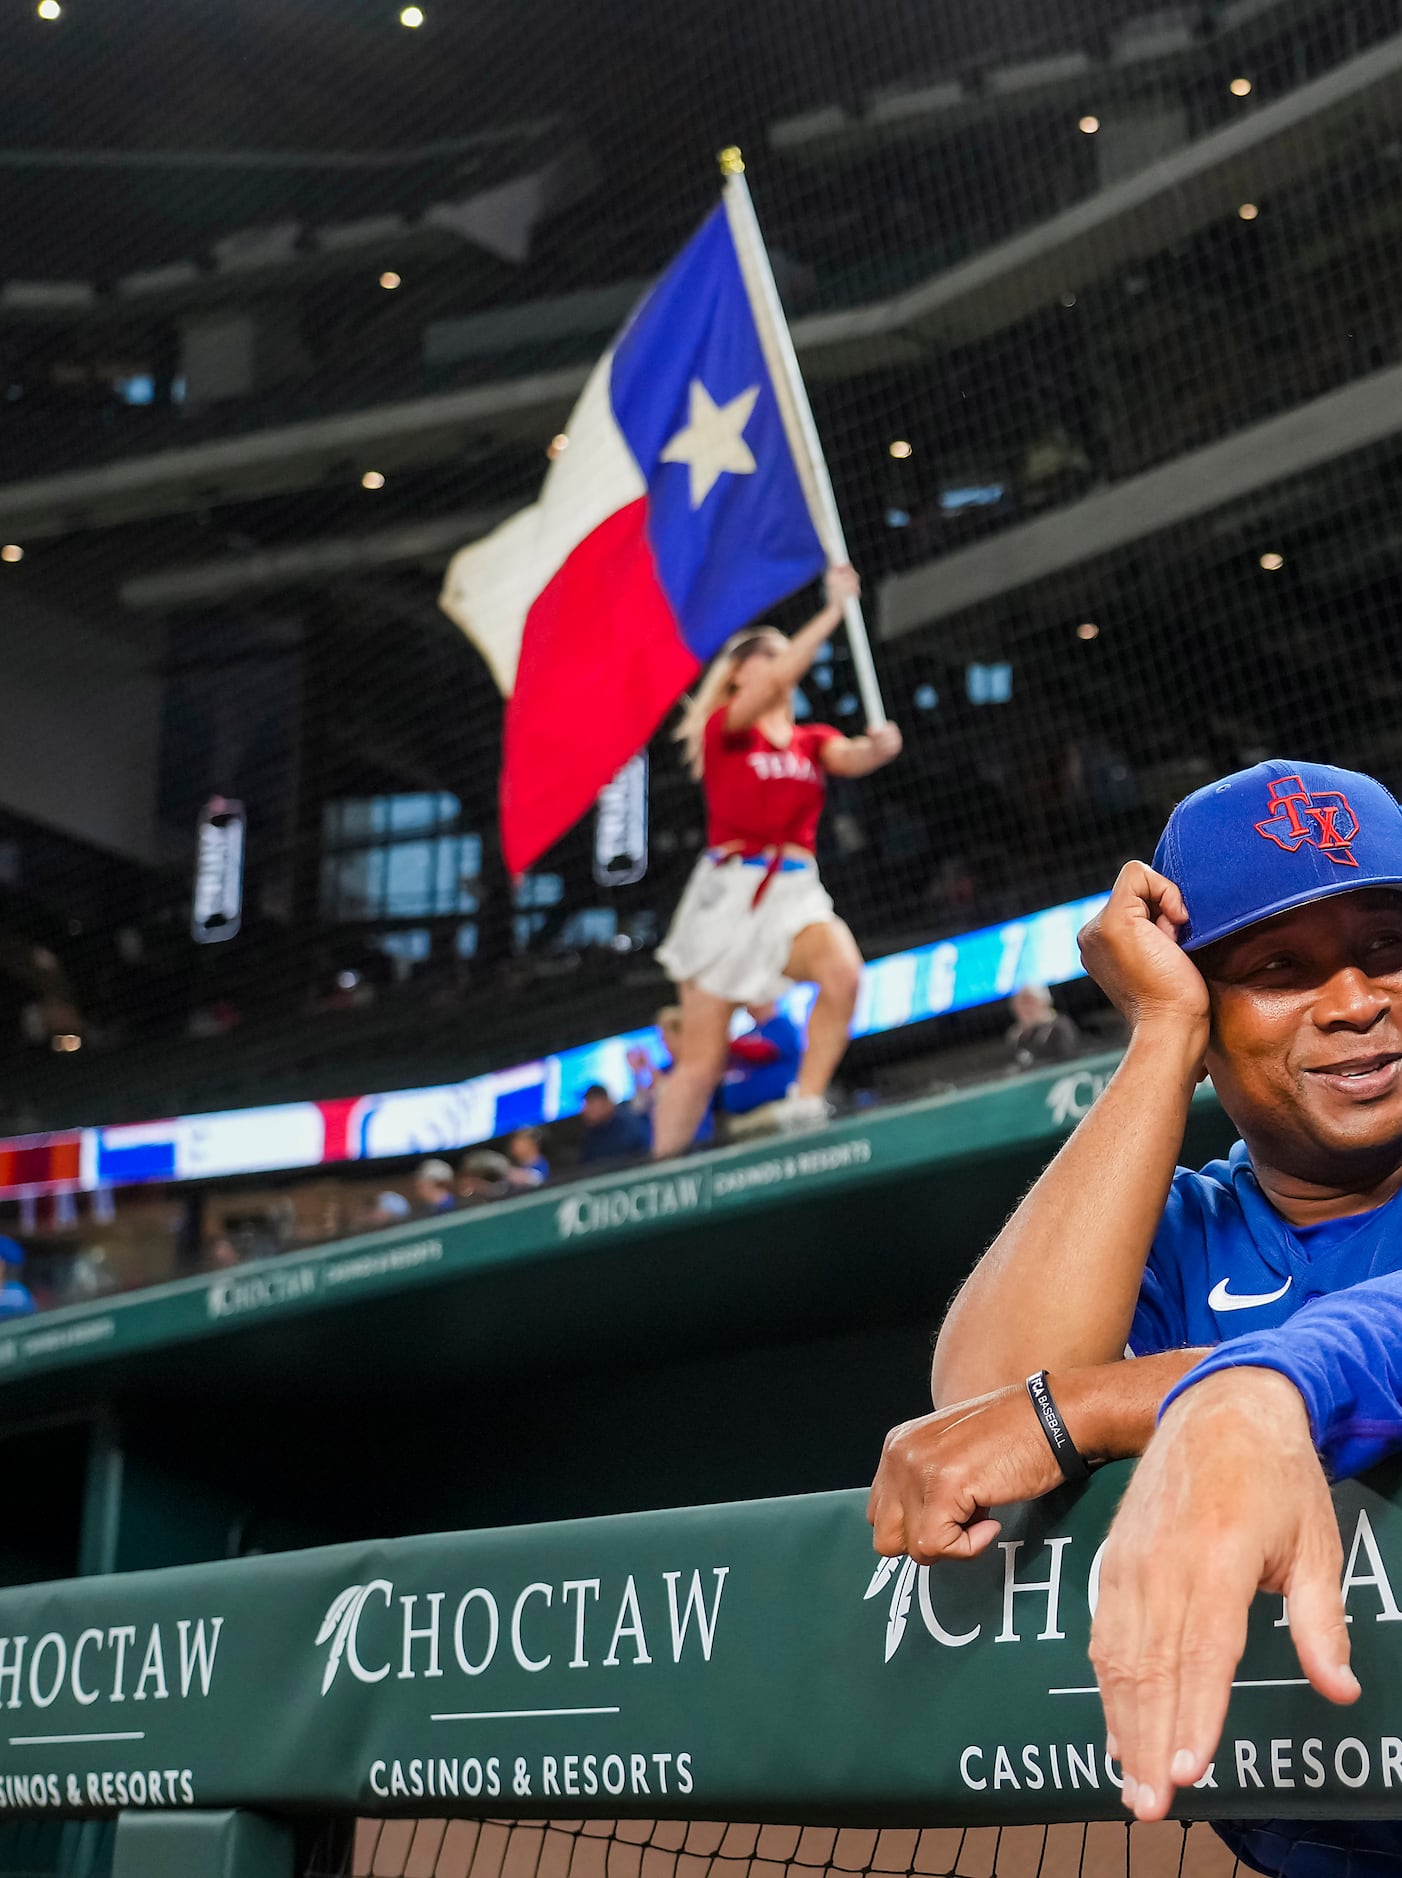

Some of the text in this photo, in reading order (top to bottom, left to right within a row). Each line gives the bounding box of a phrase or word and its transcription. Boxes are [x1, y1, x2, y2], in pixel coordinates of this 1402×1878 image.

[1038, 1395, 1066, 1449] BASEBALL
[346, 1567, 729, 1683] CHOCTAW
[67, 1773, 83, 1806] &
[87, 1769, 194, 1805] RESORTS
[369, 1752, 694, 1797] CASINOS & RESORTS
[960, 1743, 1126, 1791] CASIN
